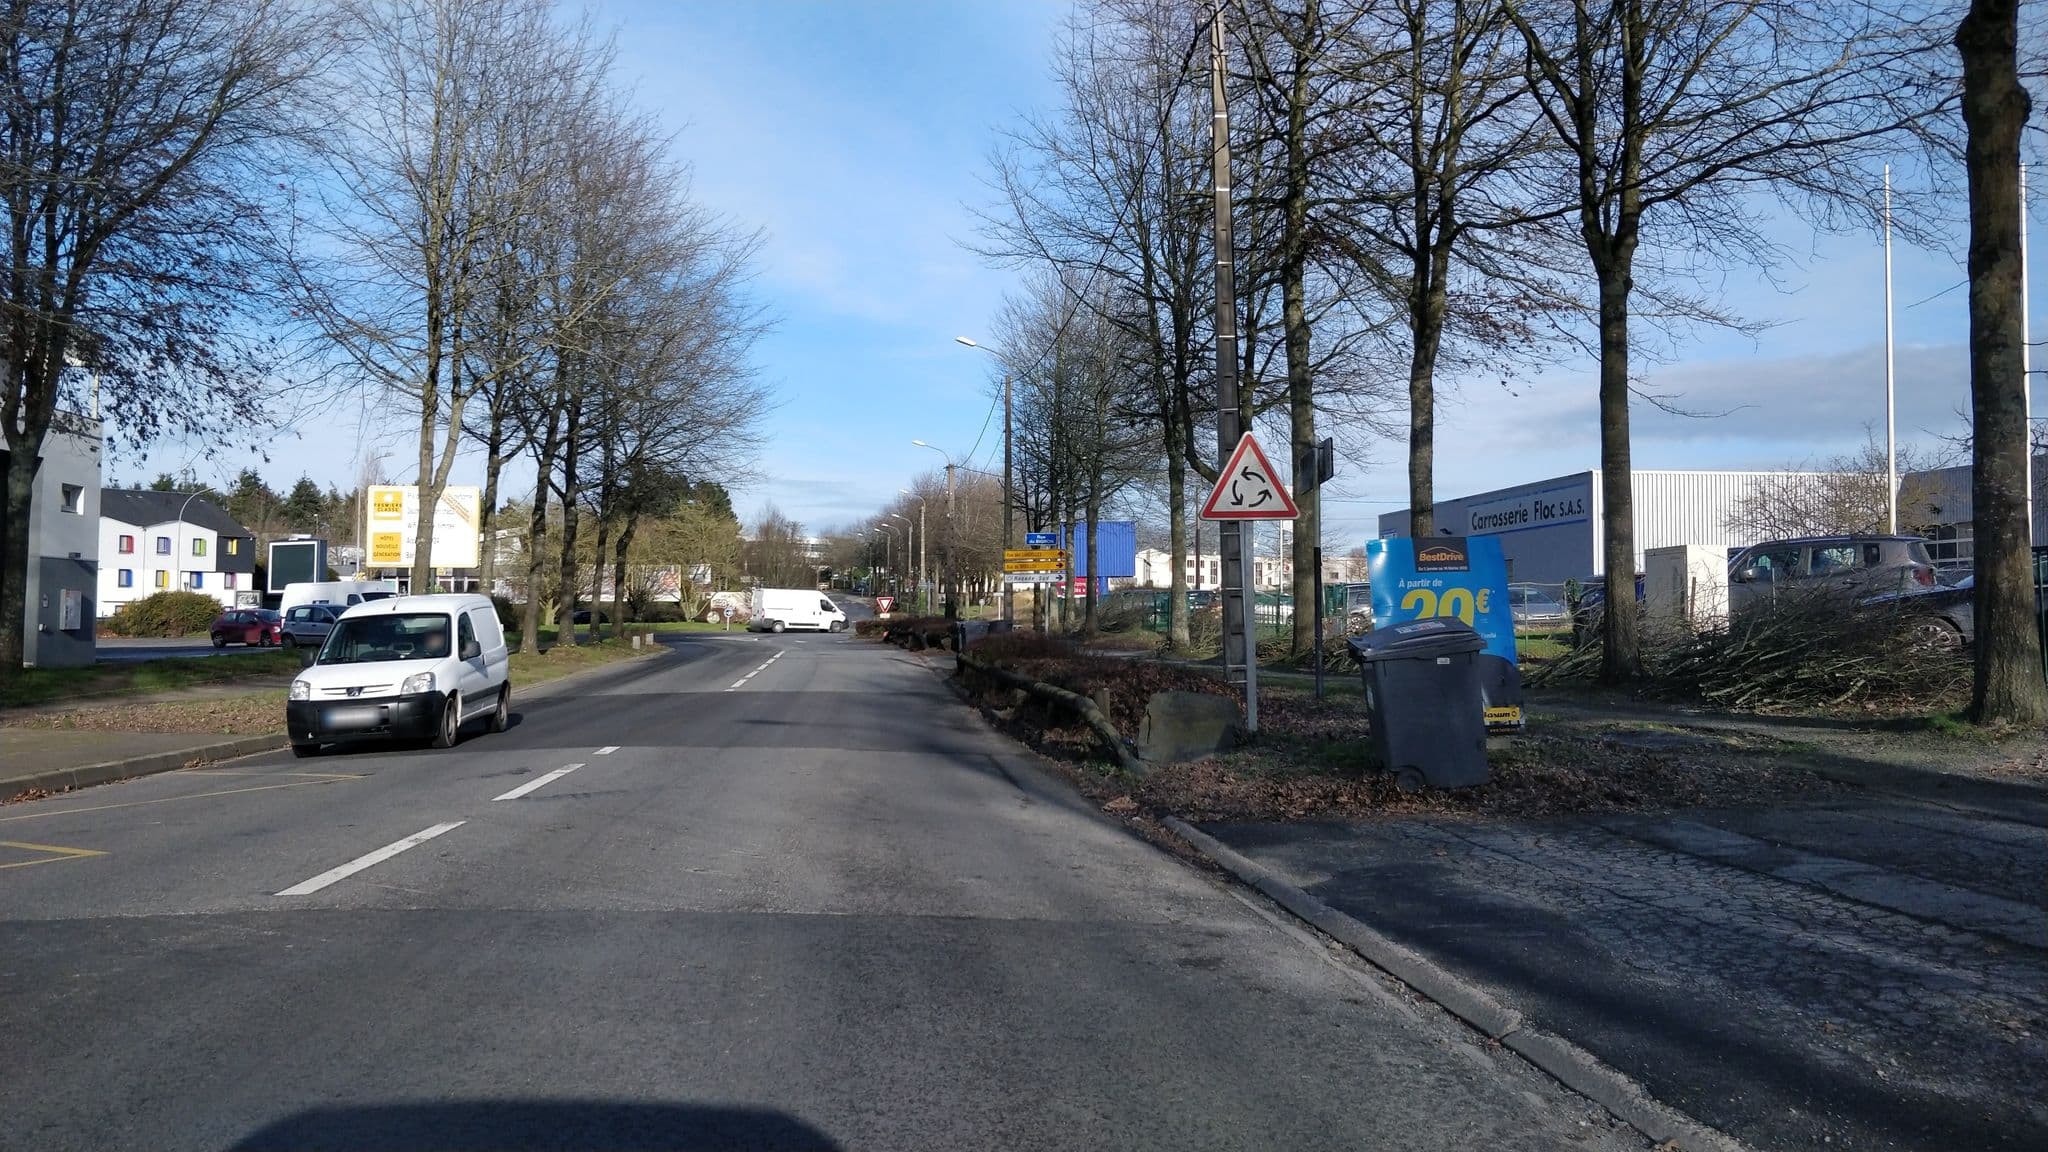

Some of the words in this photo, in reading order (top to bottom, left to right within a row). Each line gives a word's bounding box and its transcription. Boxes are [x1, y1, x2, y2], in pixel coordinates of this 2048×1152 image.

[1471, 503, 1529, 531] Carrosserie
[1534, 499, 1556, 521] Floc
[1559, 498, 1585, 518] S.A.S.
[1418, 552, 1464, 562] BestDrive
[1407, 578, 1430, 589] partir
[1432, 577, 1443, 588] de
